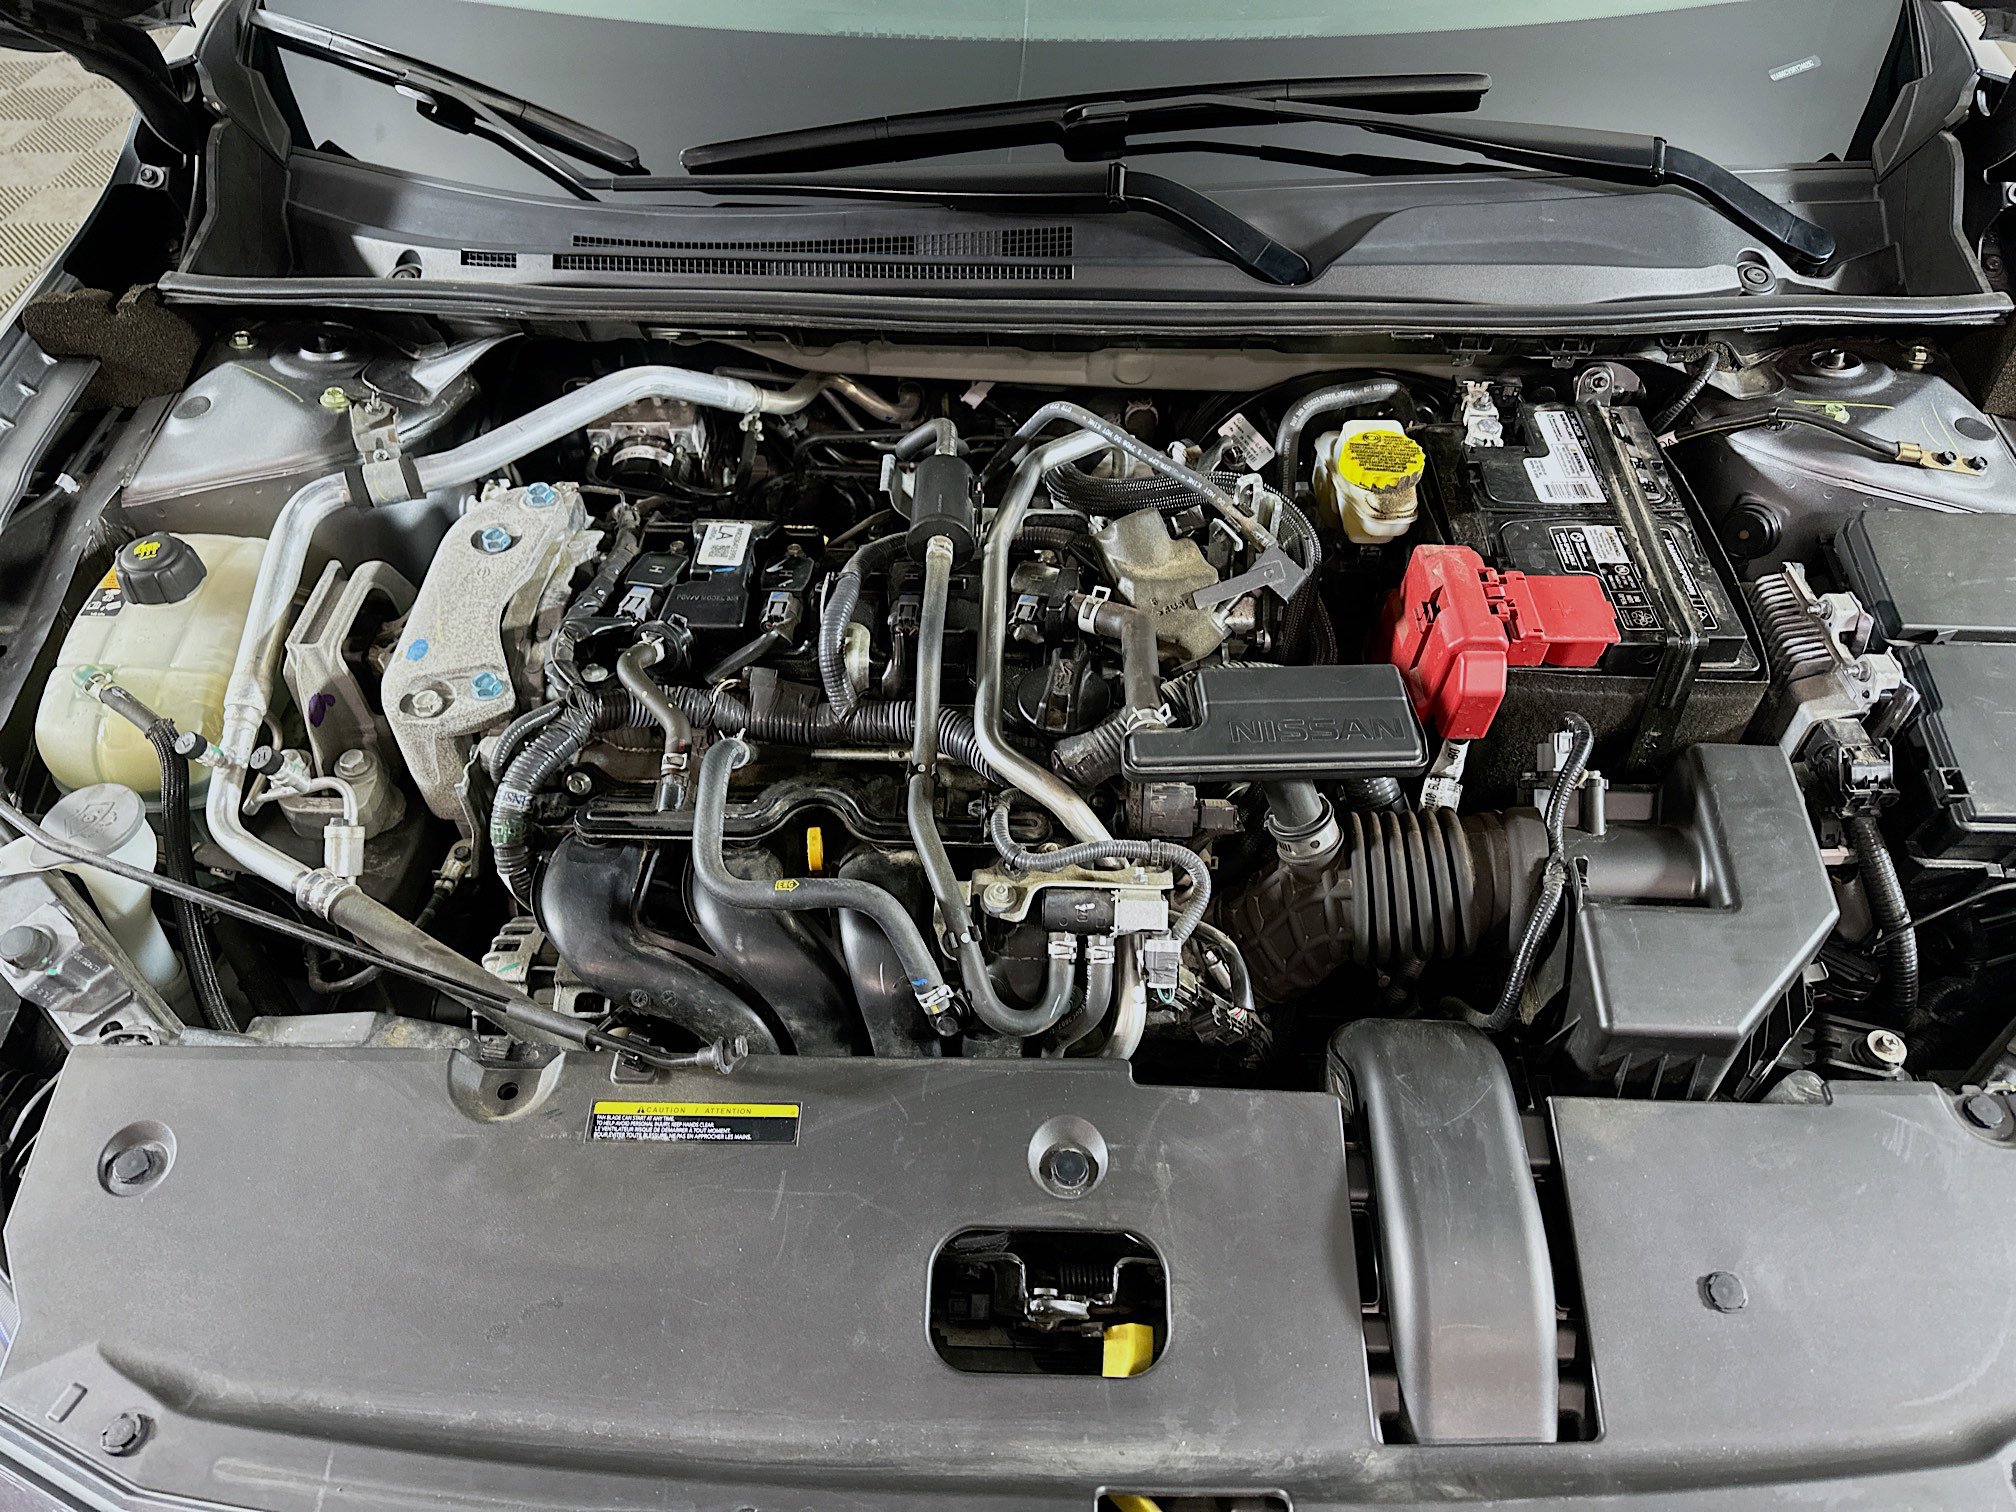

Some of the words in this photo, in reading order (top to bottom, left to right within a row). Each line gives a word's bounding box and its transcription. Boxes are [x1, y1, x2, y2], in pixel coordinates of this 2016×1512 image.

[1229, 717, 1406, 743] NISSAN
[646, 1106, 686, 1114] CAUTION
[704, 1107, 752, 1115] ATTENTION
